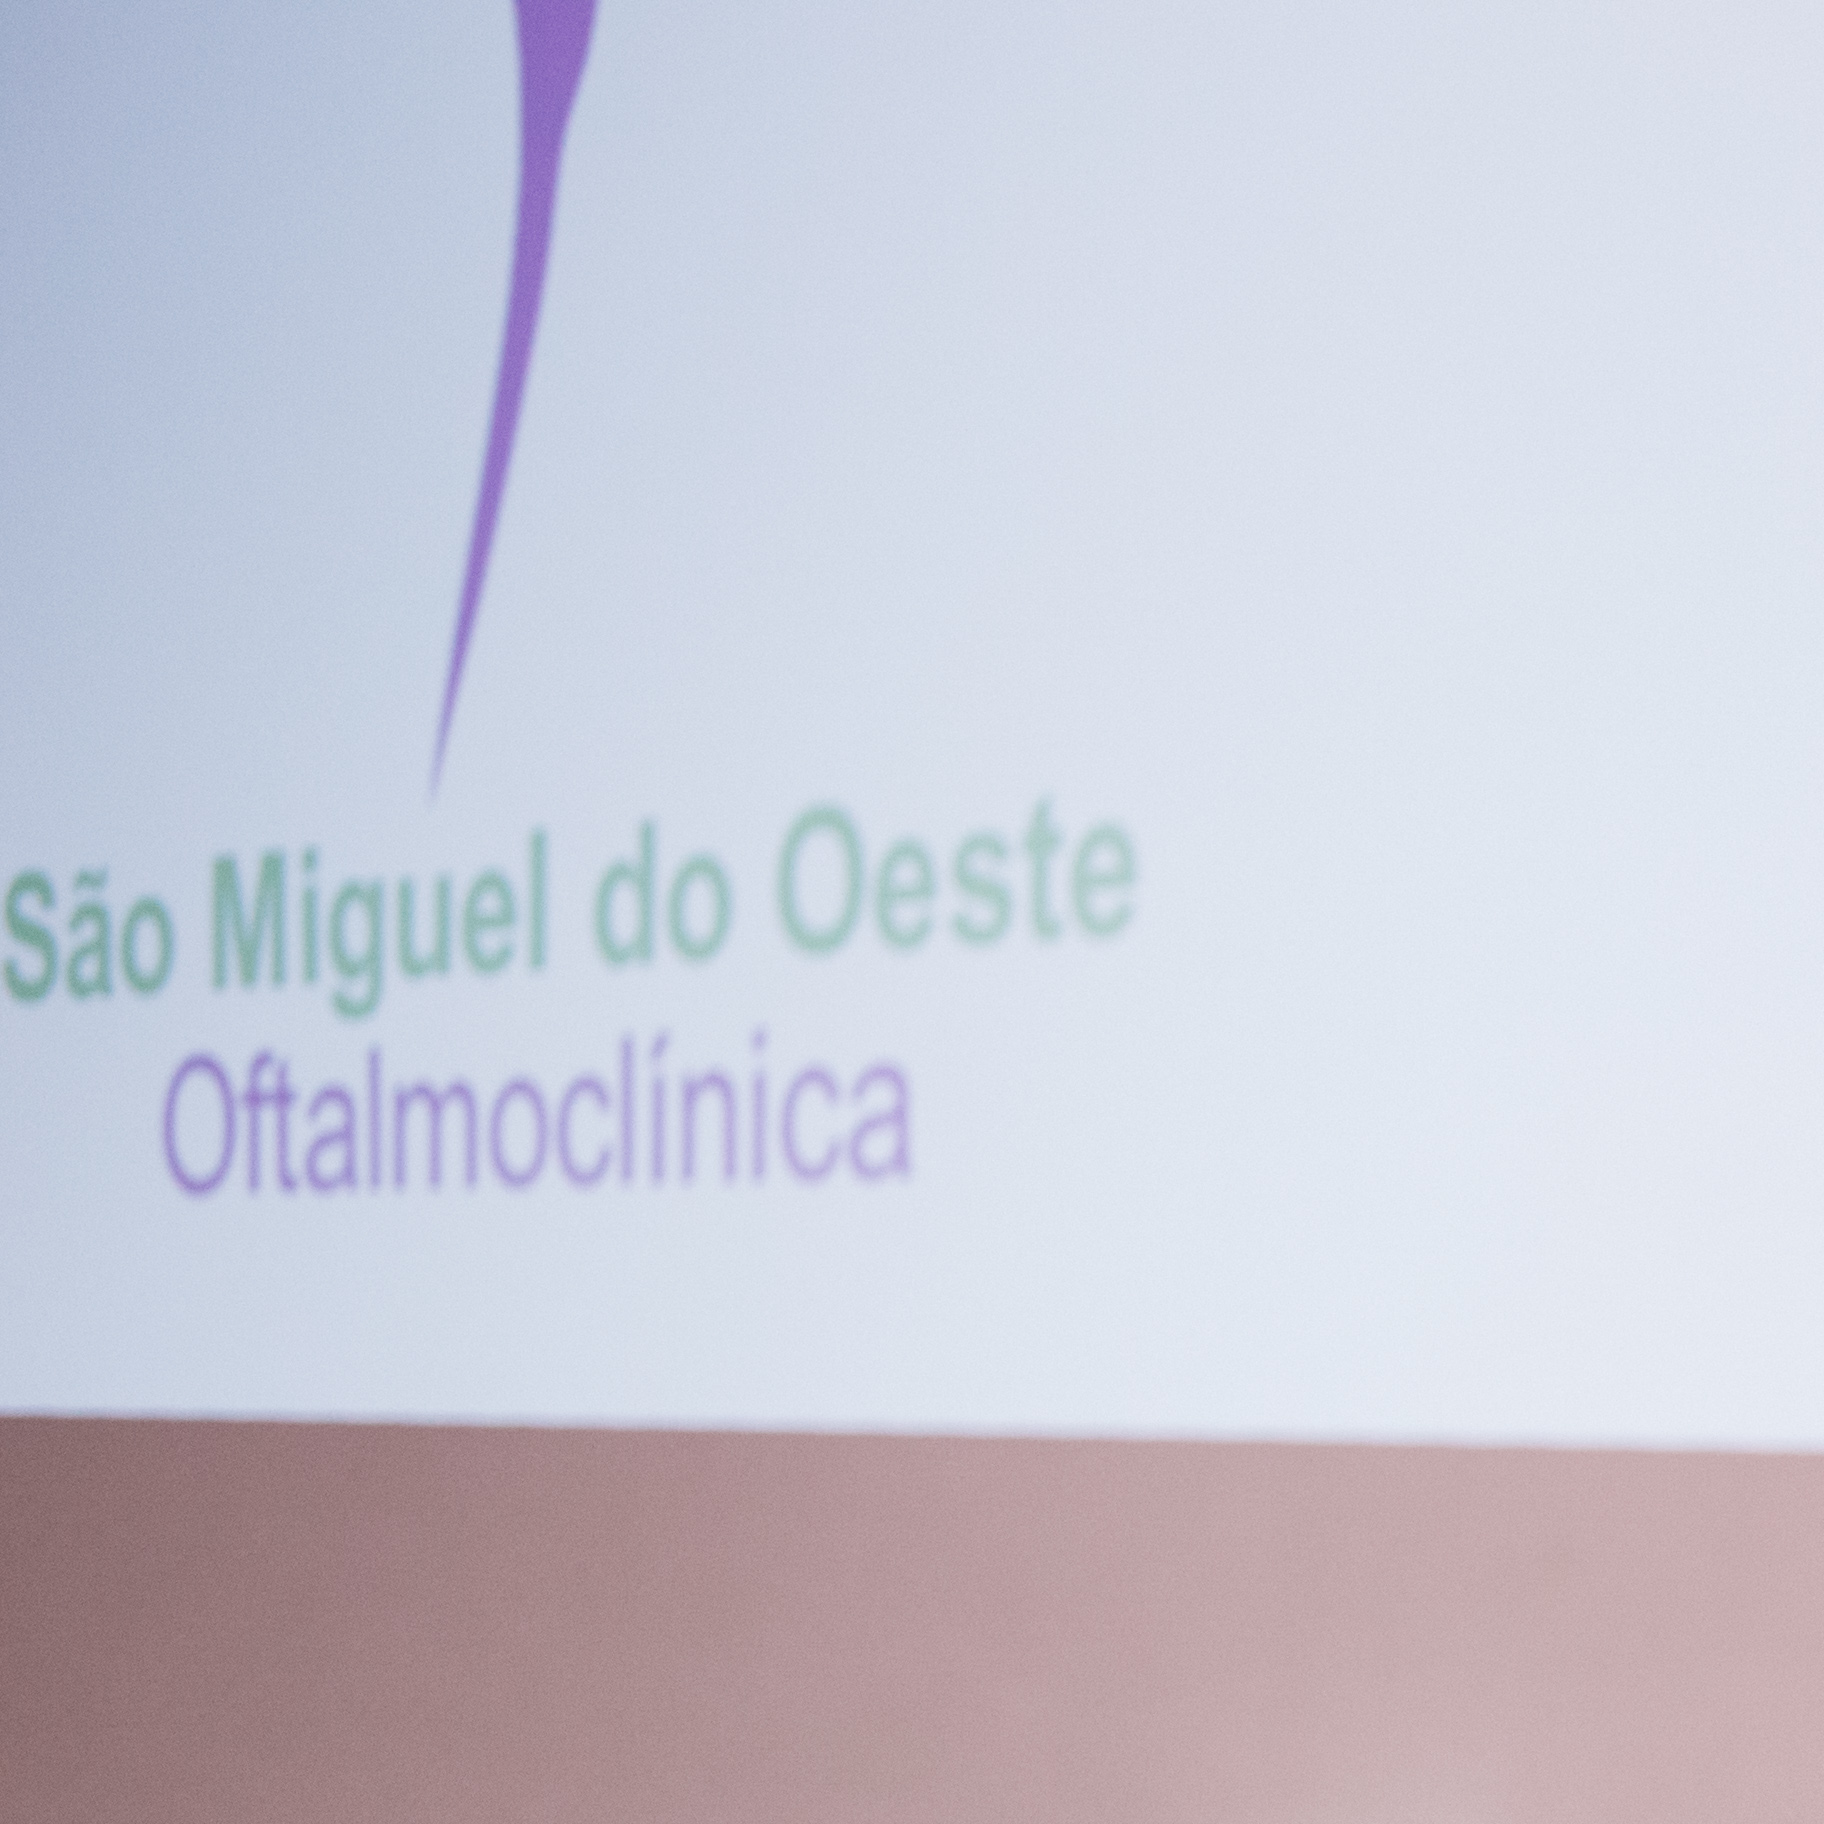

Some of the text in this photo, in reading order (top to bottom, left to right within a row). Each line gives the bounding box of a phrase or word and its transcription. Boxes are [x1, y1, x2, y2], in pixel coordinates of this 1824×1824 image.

[0, 795, 1136, 1020] São Miguel do Oeste
[164, 1027, 911, 1198] Oftalmoclínica
